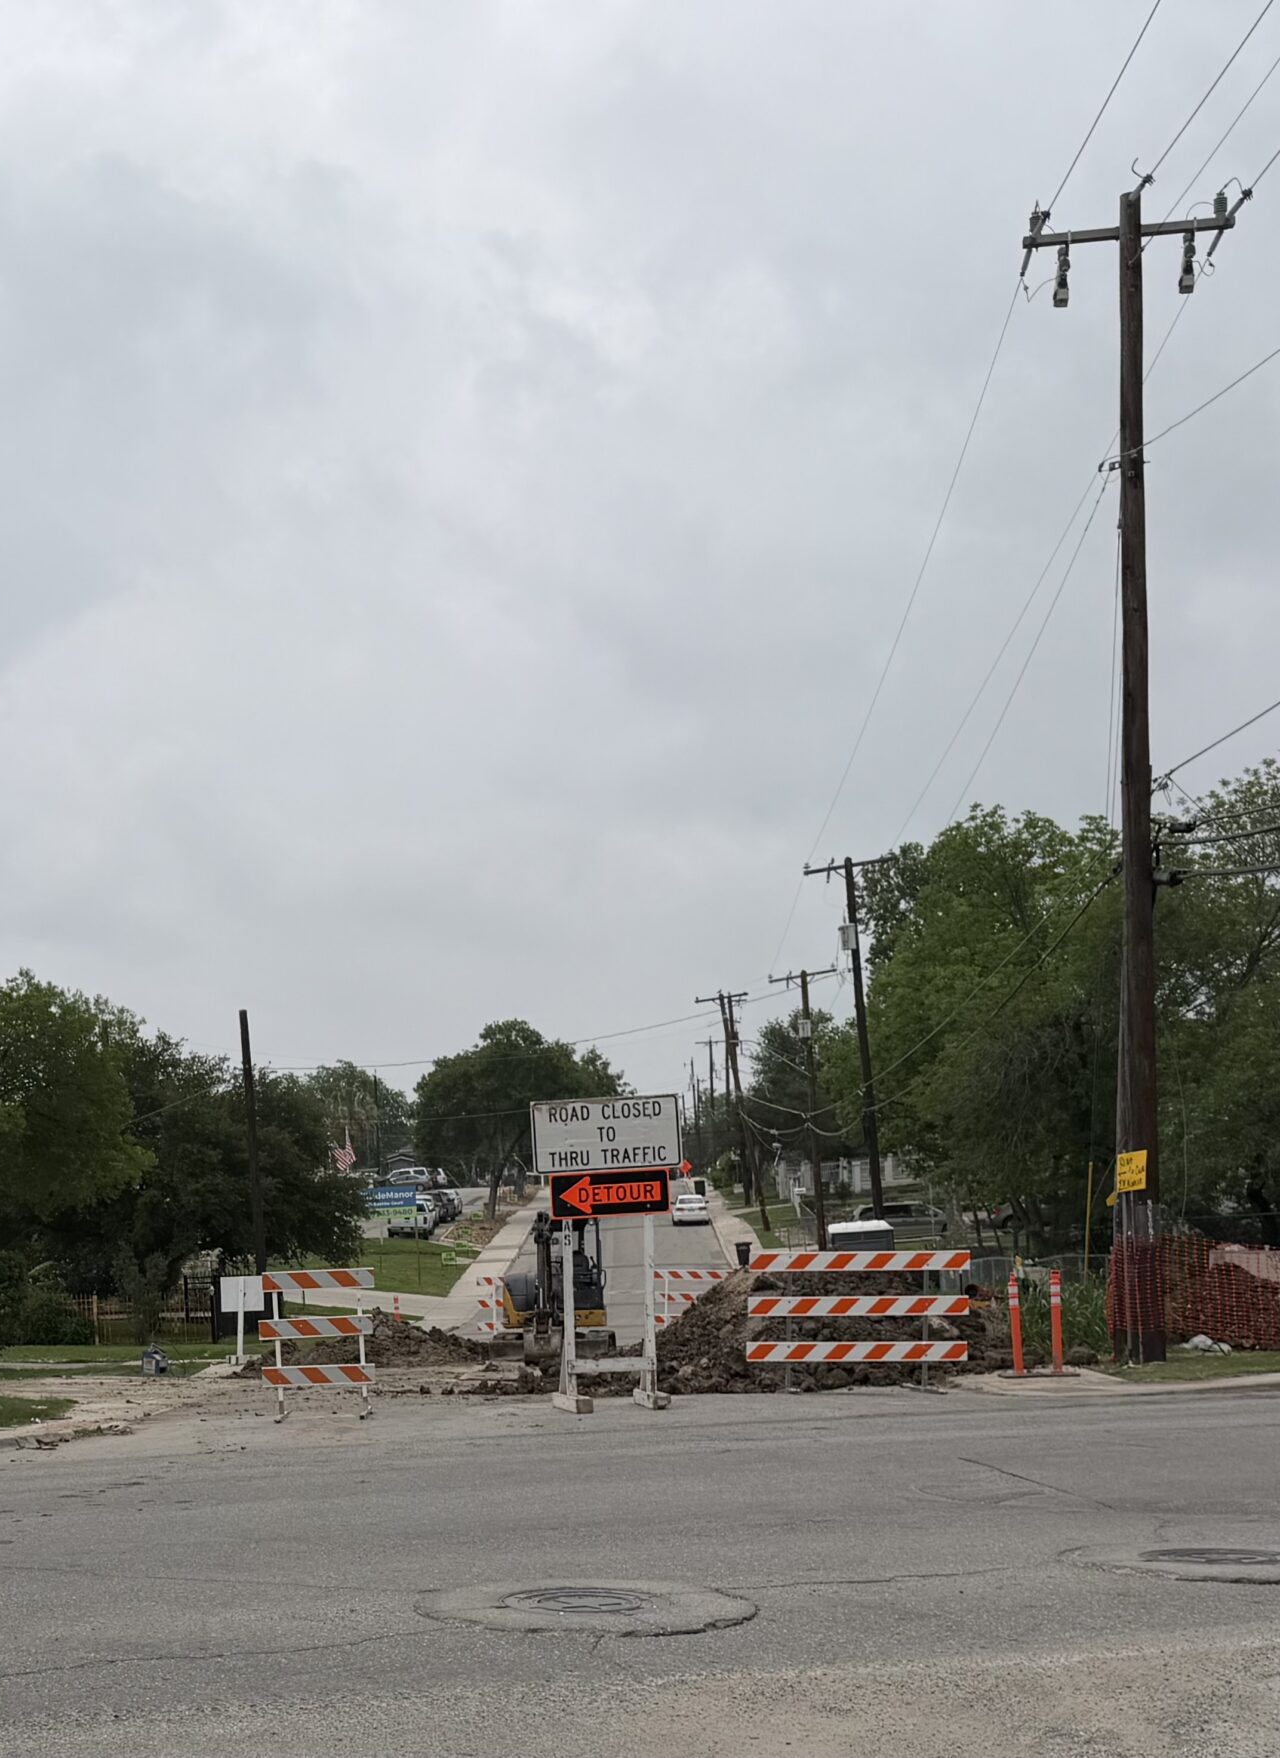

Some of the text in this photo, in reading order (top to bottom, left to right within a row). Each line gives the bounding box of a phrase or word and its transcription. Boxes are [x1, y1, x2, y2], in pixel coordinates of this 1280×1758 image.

[548, 1101, 662, 1123] ROAD CLOSED
[596, 1126, 616, 1143] TO
[548, 1146, 667, 1168] THRU TRAFFIC
[578, 1184, 655, 1204] DETOUR
